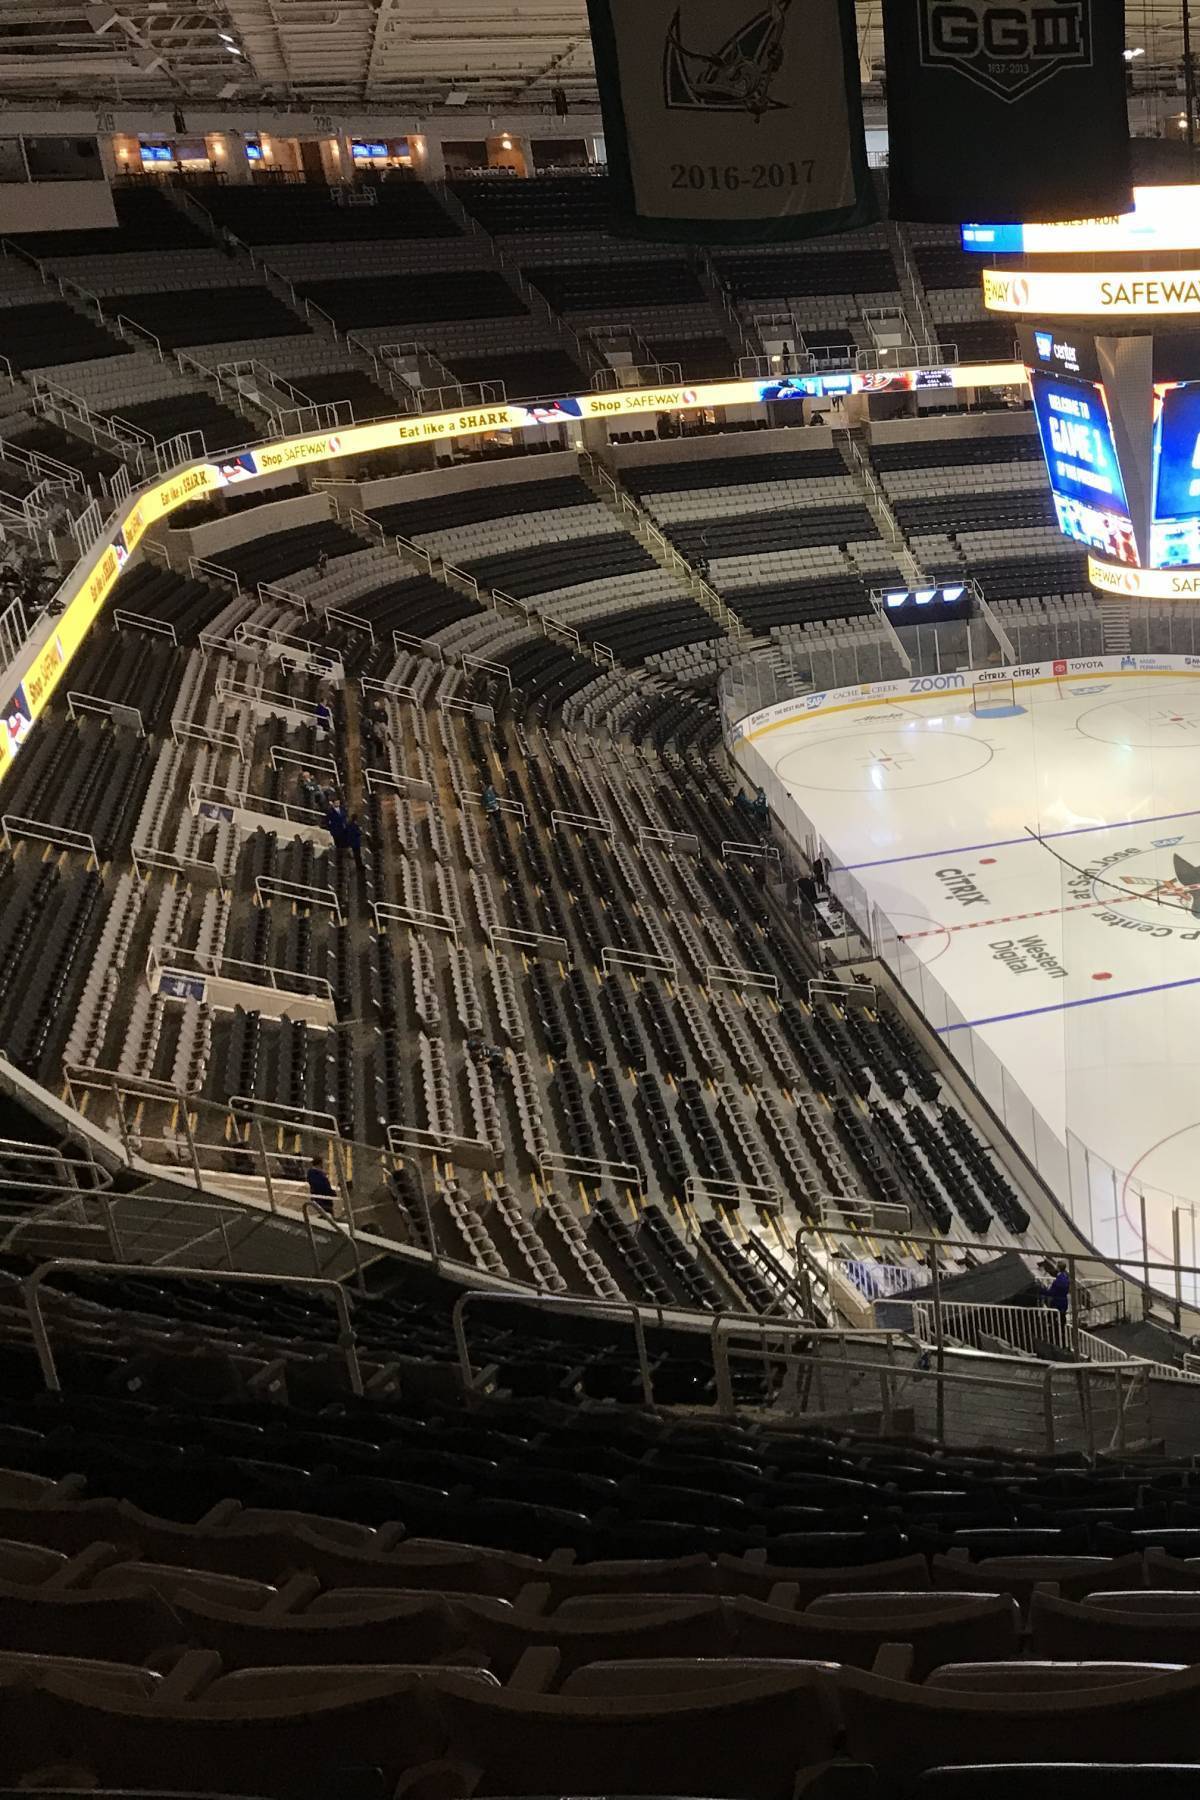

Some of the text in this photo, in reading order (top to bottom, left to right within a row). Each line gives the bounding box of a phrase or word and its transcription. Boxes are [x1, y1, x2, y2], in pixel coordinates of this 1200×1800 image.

[671, 160, 815, 190] 2016-2017
[590, 393, 680, 412] Shop SAFEWAY
[400, 427, 420, 439] Eat
[423, 422, 445, 435] like
[448, 423, 456, 431] a
[262, 441, 326, 467] Shop SAFEWAY
[1069, 660, 1104, 670] TOYOTA
[1091, 910, 1174, 939] Center
[988, 940, 1038, 975] Digital
[1017, 934, 1069, 979] Western
